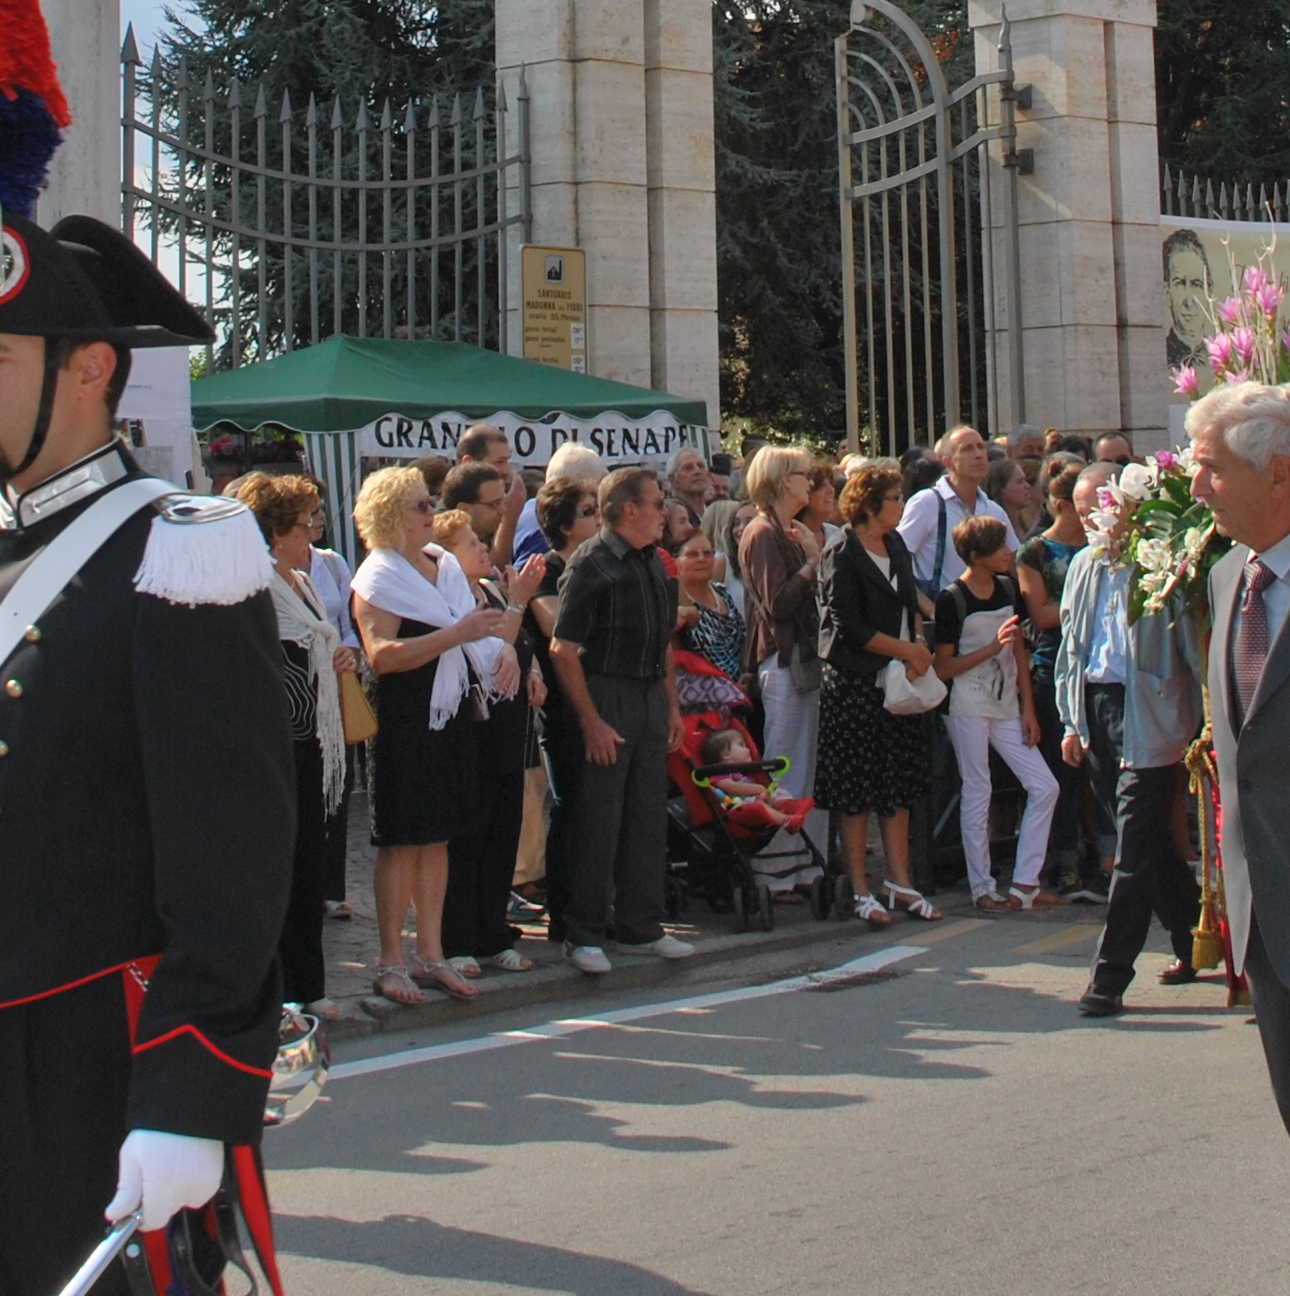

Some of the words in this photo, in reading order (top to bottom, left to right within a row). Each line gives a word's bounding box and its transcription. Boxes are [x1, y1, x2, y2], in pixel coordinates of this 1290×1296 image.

[537, 288, 572, 300] SANTUARIO
[526, 300, 556, 311] MADONNA
[566, 302, 583, 312] FIORI
[375, 416, 536, 457] GRANO
